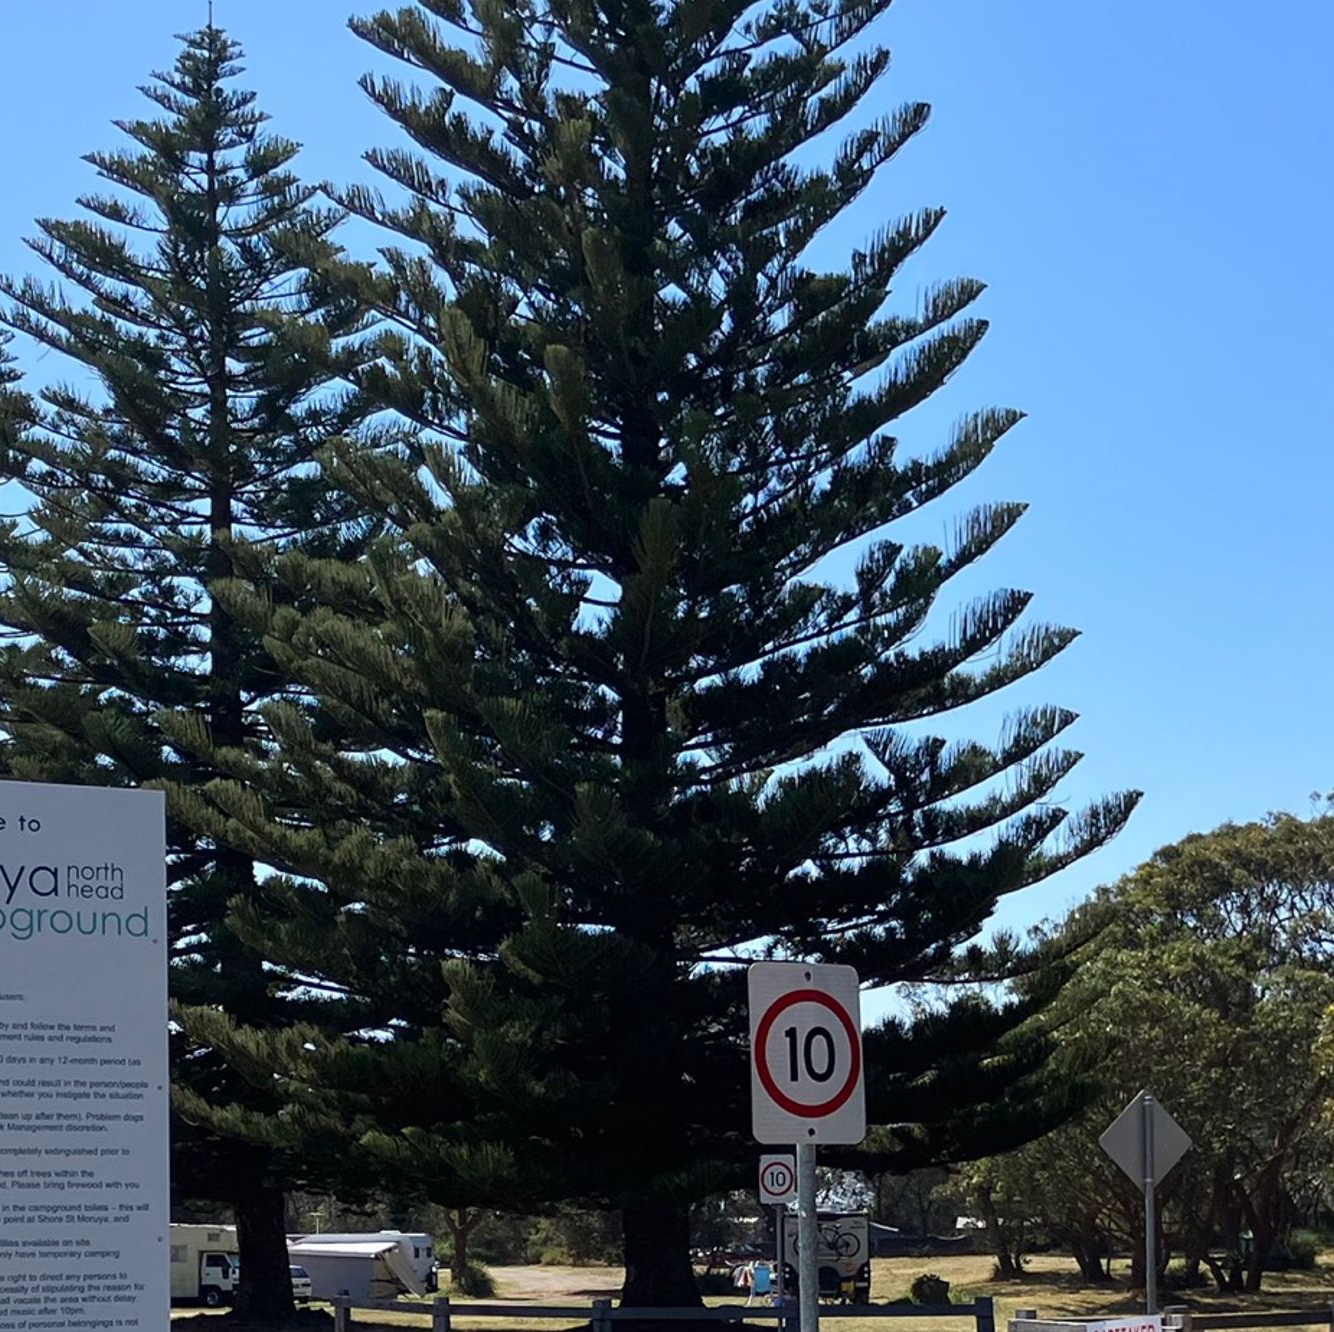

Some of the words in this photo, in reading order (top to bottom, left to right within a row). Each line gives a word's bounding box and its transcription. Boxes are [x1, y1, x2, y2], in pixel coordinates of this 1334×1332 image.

[19, 814, 41, 832] to
[67, 862, 123, 882] north
[67, 881, 123, 900] head
[11, 1021, 28, 1029] and
[29, 1022, 55, 1030] follow
[57, 1022, 71, 1030] the
[73, 1022, 97, 1031] terms
[99, 1023, 115, 1031] and
[23, 1032, 45, 1040] rules
[47, 1033, 63, 1041] and
[65, 1033, 112, 1043] regulations
[784, 1026, 835, 1083] 10
[11, 1180, 40, 1188] Please
[43, 1180, 65, 1190] bring
[67, 1180, 103, 1188] firewood
[105, 1180, 122, 1188] with
[124, 1182, 139, 1190] you
[770, 1171, 786, 1187] 10
[21, 1238, 59, 1246] available
[9, 1307, 35, 1316] music
[37, 1307, 57, 1315] after
